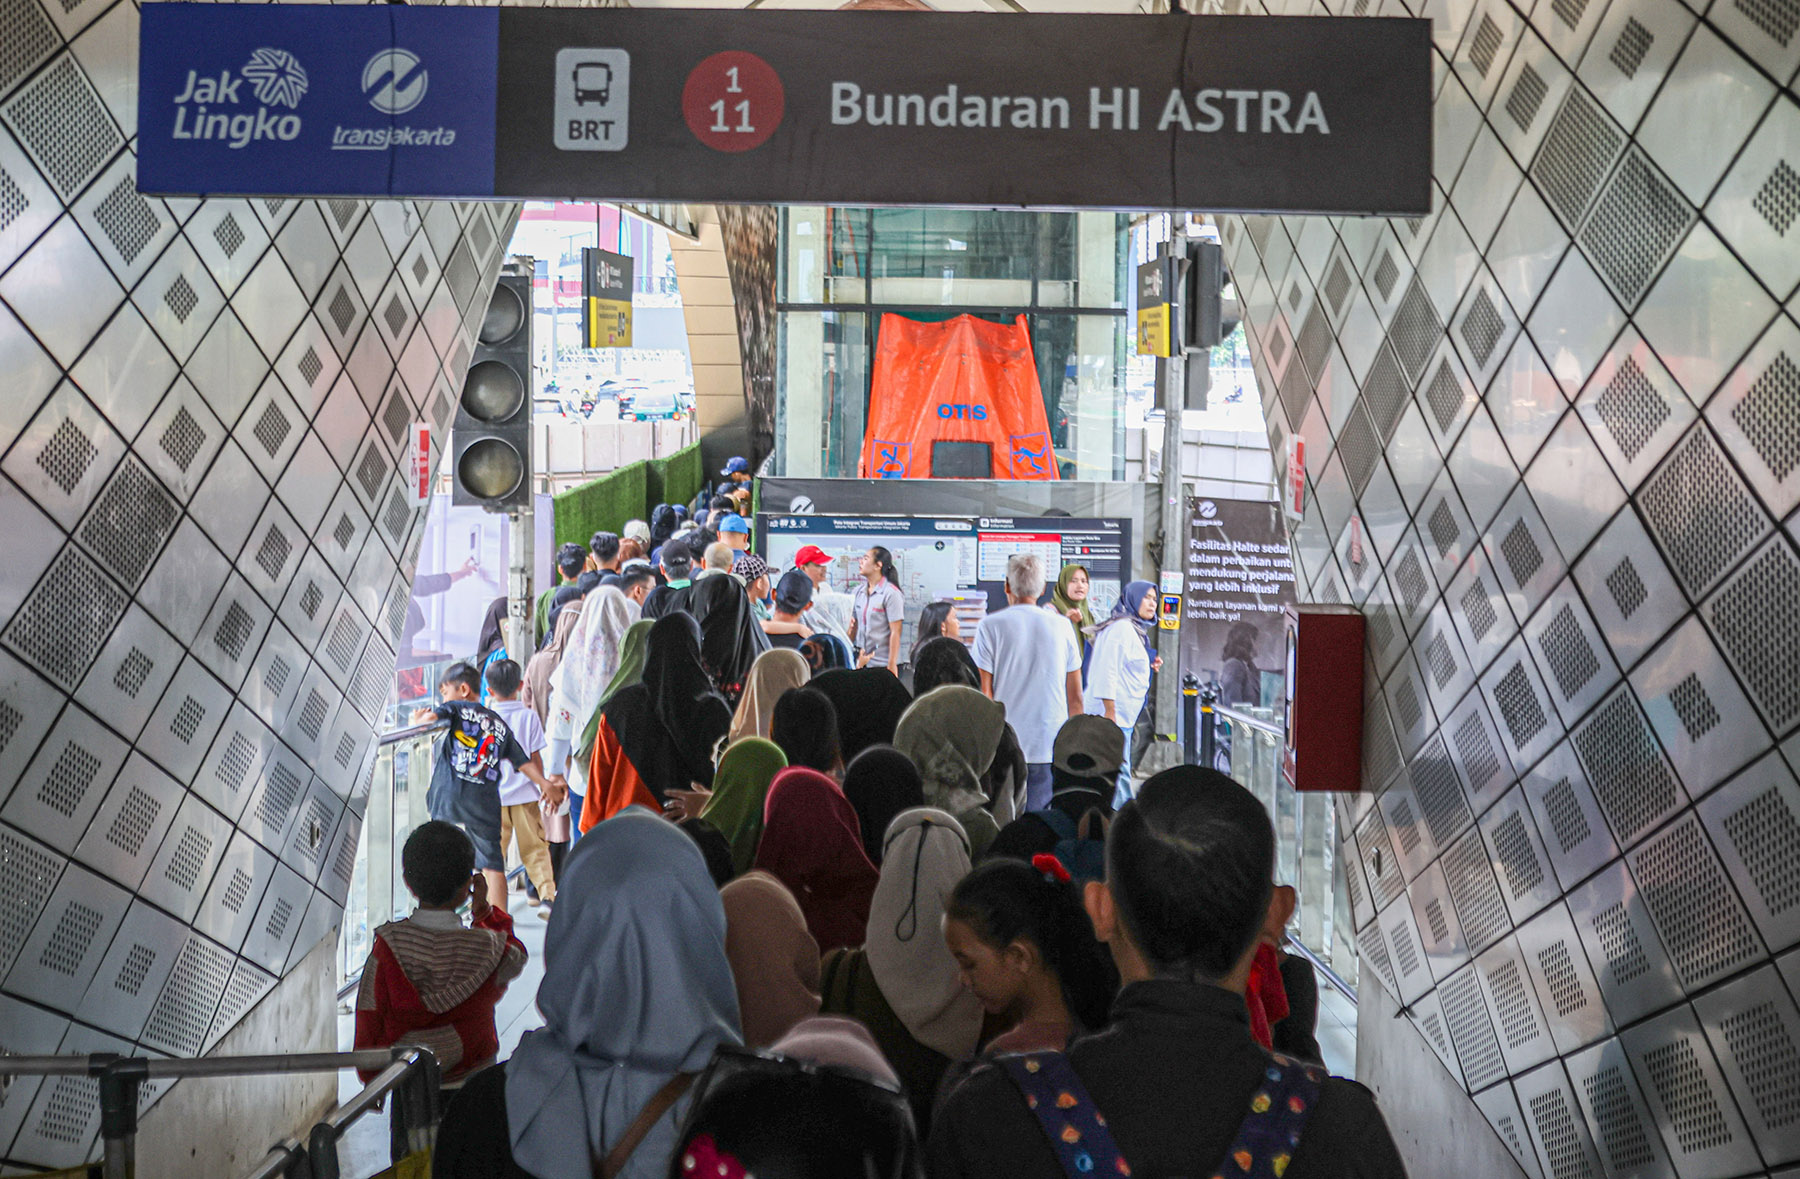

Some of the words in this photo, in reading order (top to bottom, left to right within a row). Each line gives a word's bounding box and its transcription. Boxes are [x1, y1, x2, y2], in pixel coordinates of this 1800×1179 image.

[174, 70, 243, 104] Jak
[726, 67, 742, 93] 1
[710, 100, 755, 132] 11
[830, 82, 1070, 129] Bundaran
[1089, 87, 1140, 130] HI
[1158, 88, 1331, 134] ASTRA
[172, 106, 302, 149] Lingko
[568, 120, 615, 141] BRT
[332, 126, 456, 150] transjakarta
[937, 403, 987, 420] OTIS
[1190, 539, 1231, 551] Fasilitas
[1233, 541, 1260, 553] Halte
[1261, 544, 1290, 554] sedan
[1190, 553, 1221, 564] dalam
[1222, 555, 1272, 567] perbaikan
[1273, 559, 1293, 568] unt
[1189, 567, 1248, 582] mendukung
[1249, 571, 1295, 583] perjalana
[1188, 582, 1213, 593] yang
[1215, 581, 1240, 592] lebih
[1242, 582, 1280, 595] inklusif
[1187, 599, 1224, 609] Nantikan
[1225, 600, 1257, 612] layanan
[1258, 603, 1278, 612] kami
[1187, 609, 1208, 619] lebih
[1209, 610, 1227, 620] baik
[1228, 612, 1241, 622] ya!
